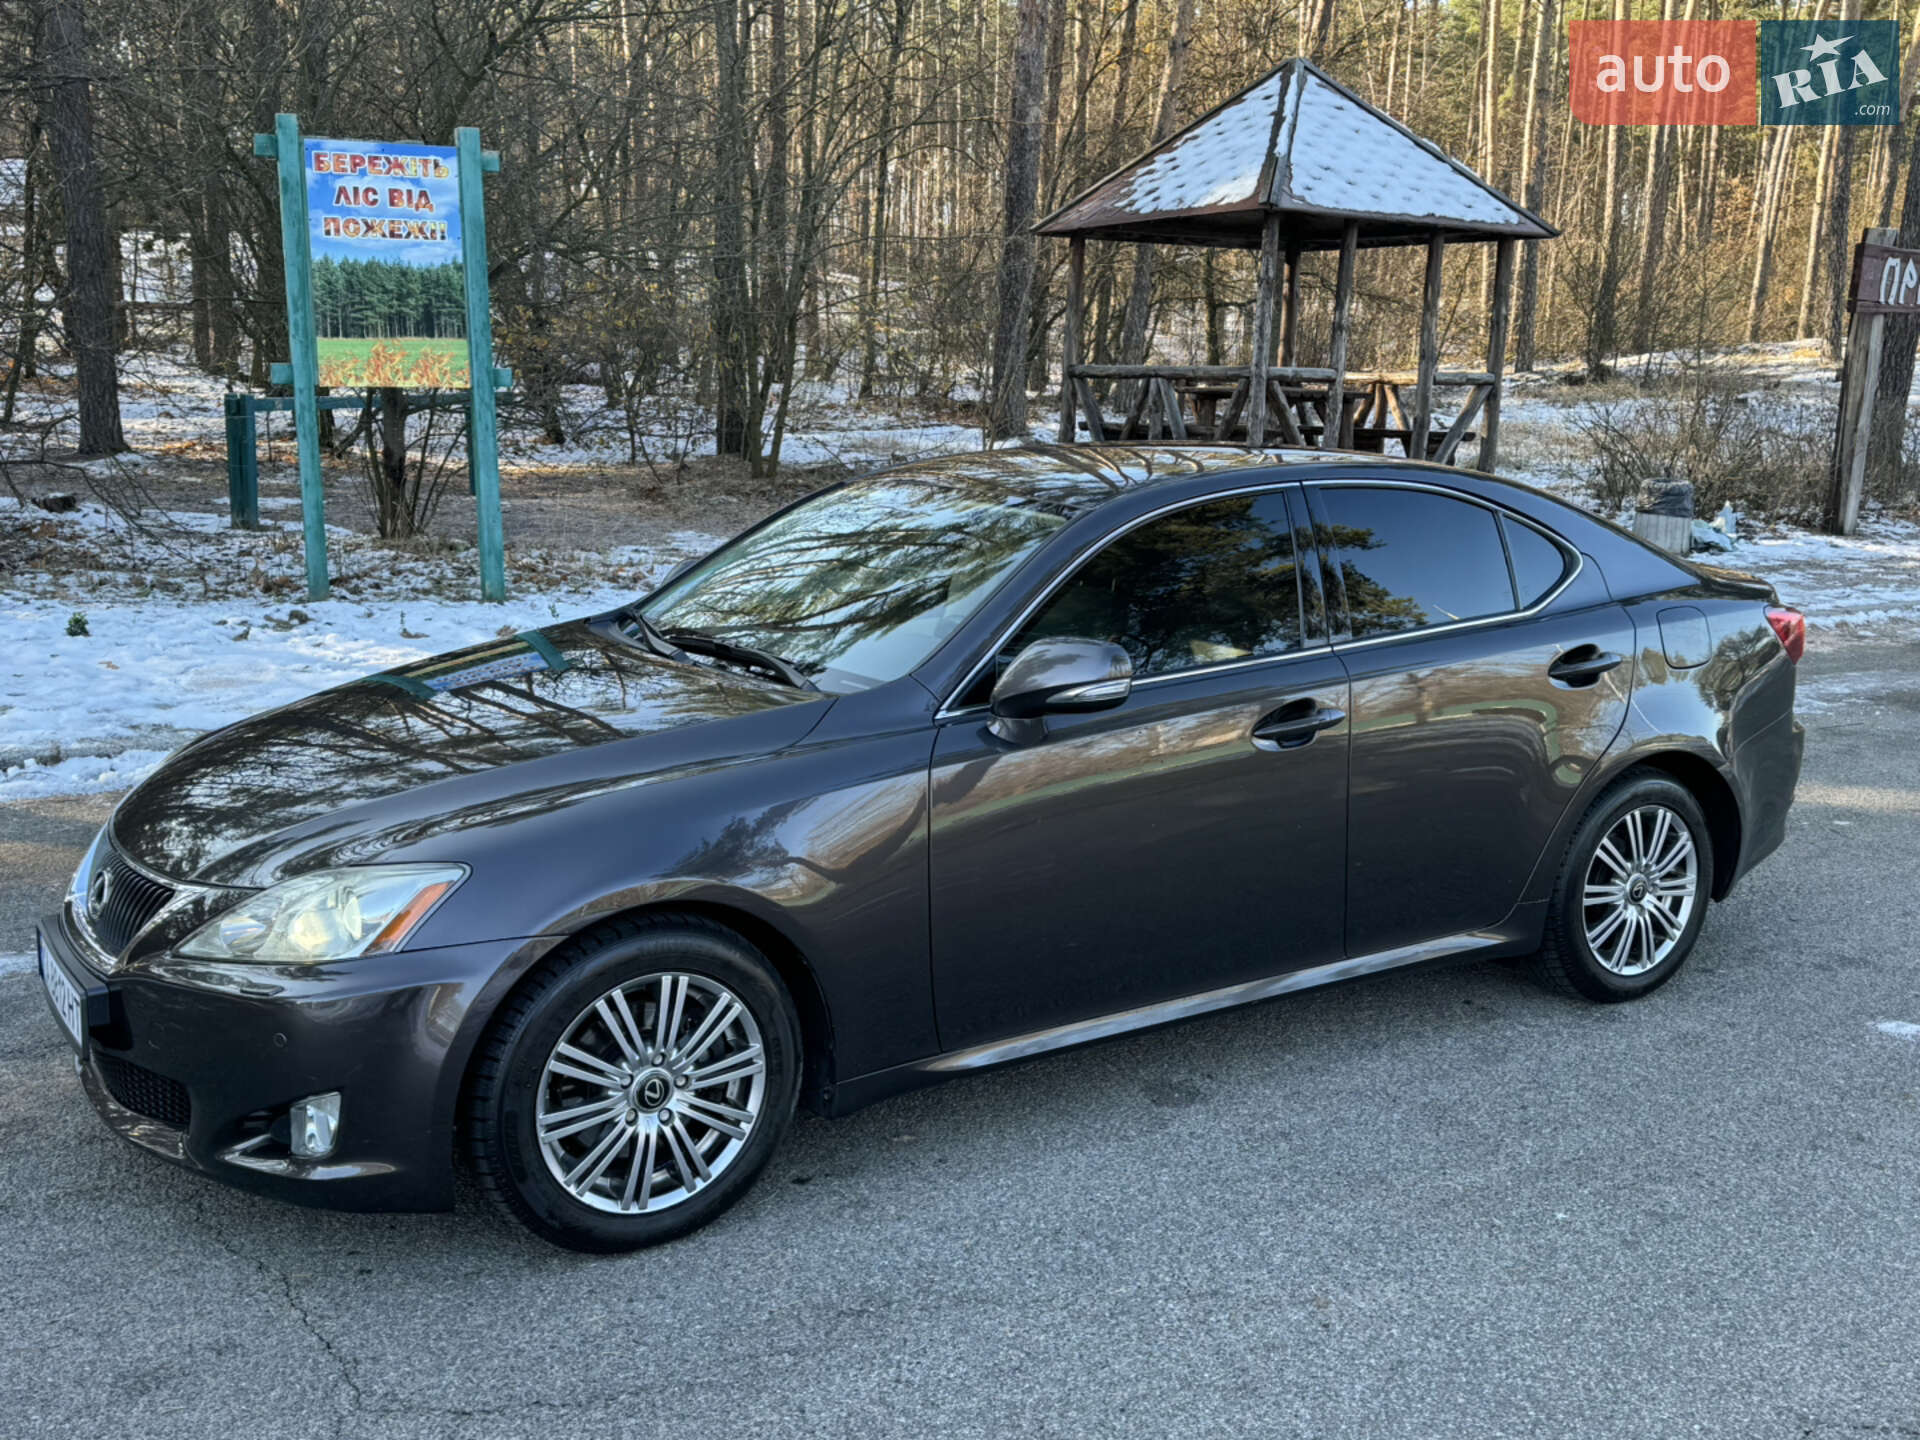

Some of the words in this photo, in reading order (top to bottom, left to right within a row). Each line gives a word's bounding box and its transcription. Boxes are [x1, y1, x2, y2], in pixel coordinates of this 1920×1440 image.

[312, 151, 450, 178] БЕРЕЖІТЬ
[334, 185, 380, 207] ЛІС
[387, 188, 435, 213] ВІД
[322, 216, 448, 241] ПОЖЕЖІ!
[1879, 257, 1920, 305] ПР
